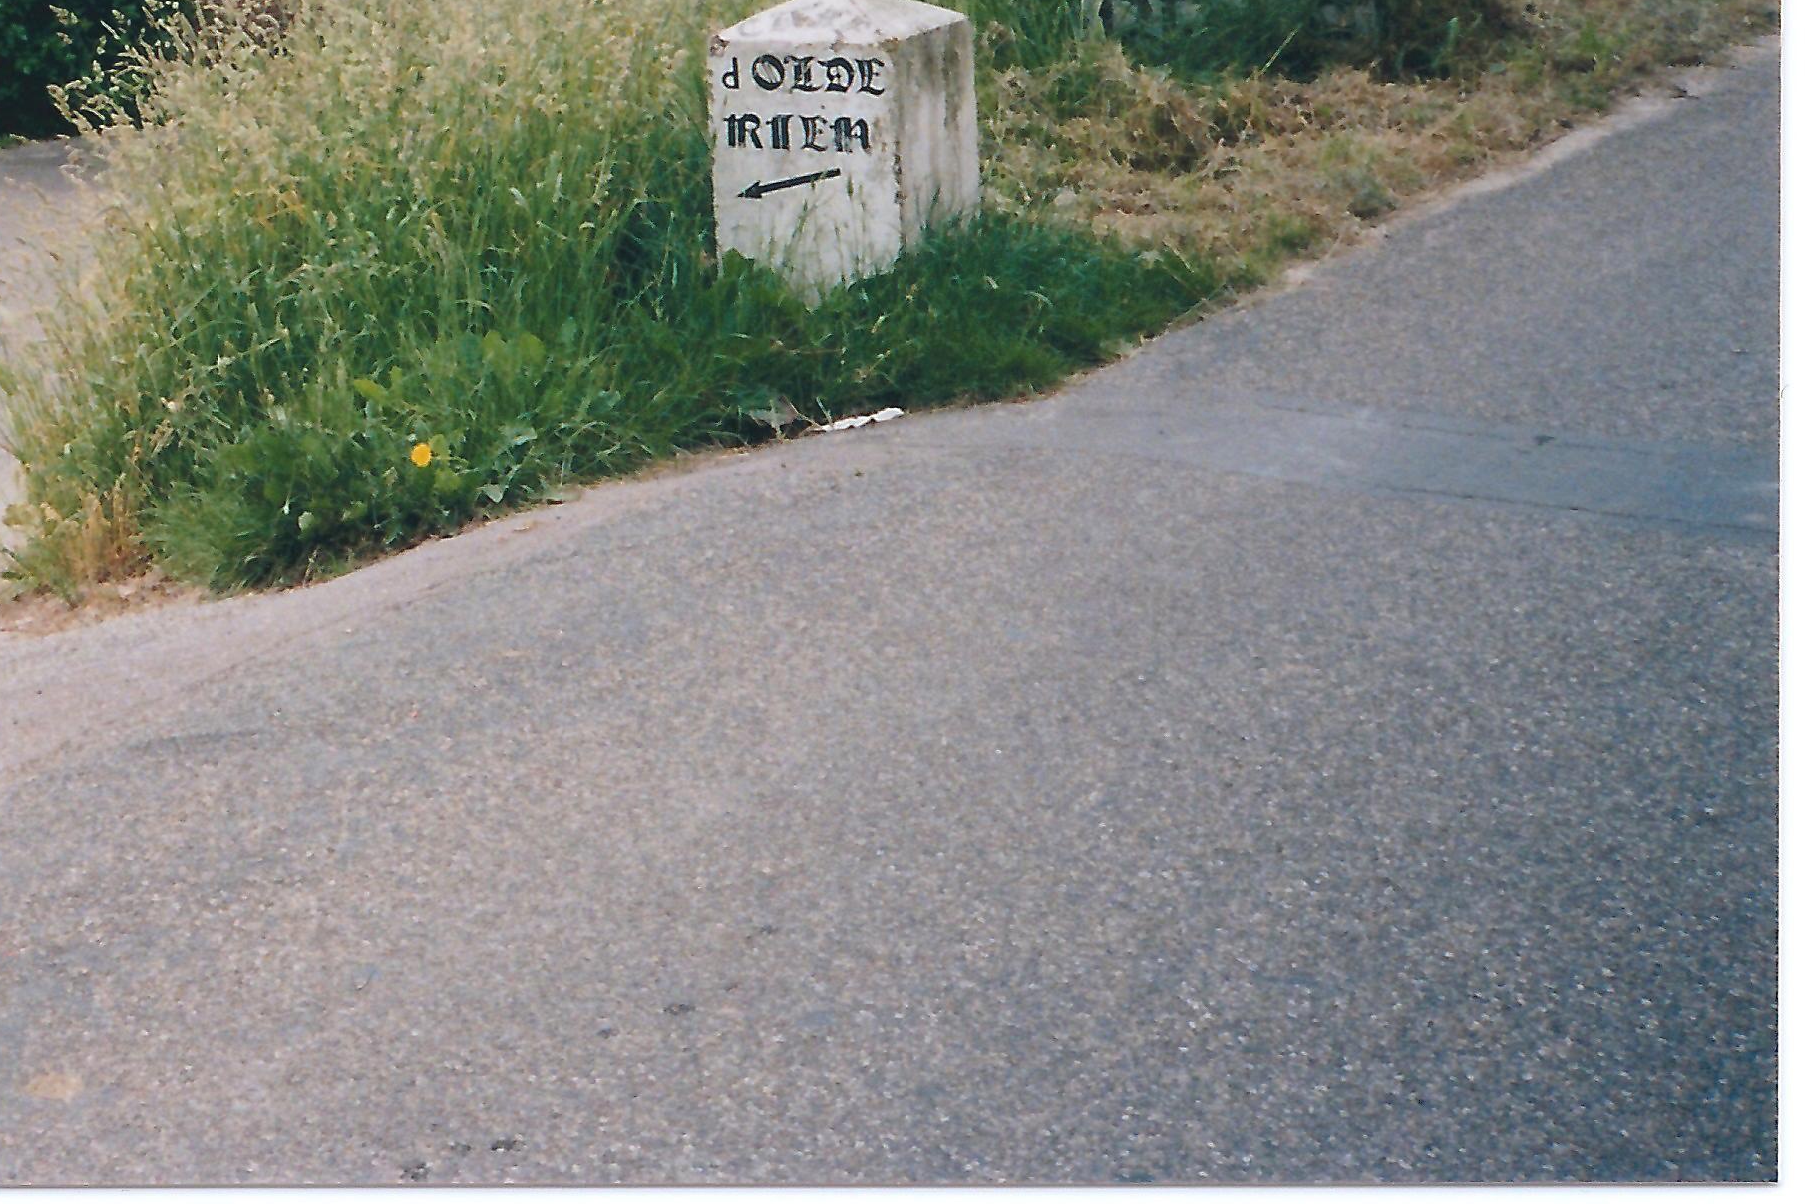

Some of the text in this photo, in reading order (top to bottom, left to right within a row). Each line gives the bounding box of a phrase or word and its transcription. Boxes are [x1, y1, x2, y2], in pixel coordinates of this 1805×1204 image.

[721, 53, 886, 96] d OLDE
[722, 112, 872, 154] RIEN
